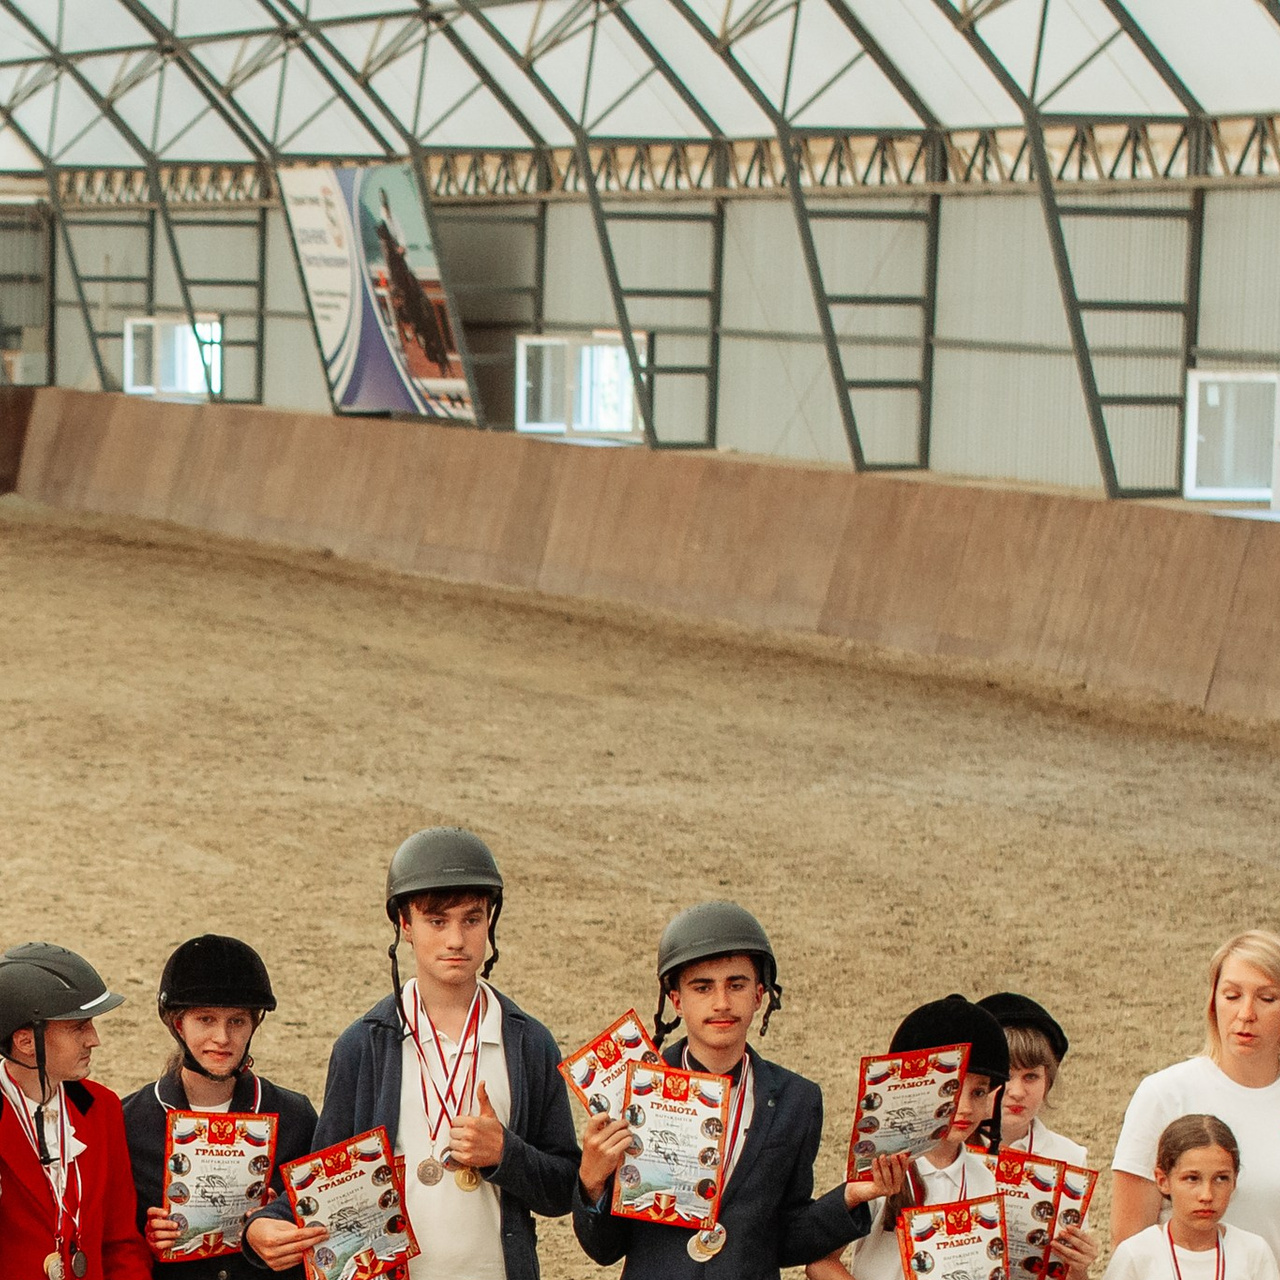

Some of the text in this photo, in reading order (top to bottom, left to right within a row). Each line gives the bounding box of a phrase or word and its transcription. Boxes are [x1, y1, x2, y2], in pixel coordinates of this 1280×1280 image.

[601, 1064, 627, 1087] ГРАМО
[887, 1079, 936, 1092] ГРАМОТА
[650, 1101, 698, 1116] ГРАМОТА
[195, 1148, 246, 1157] ГРАМОТА
[317, 1169, 366, 1193] ГРАМОТА
[936, 1236, 983, 1250] ГРАМОТА
